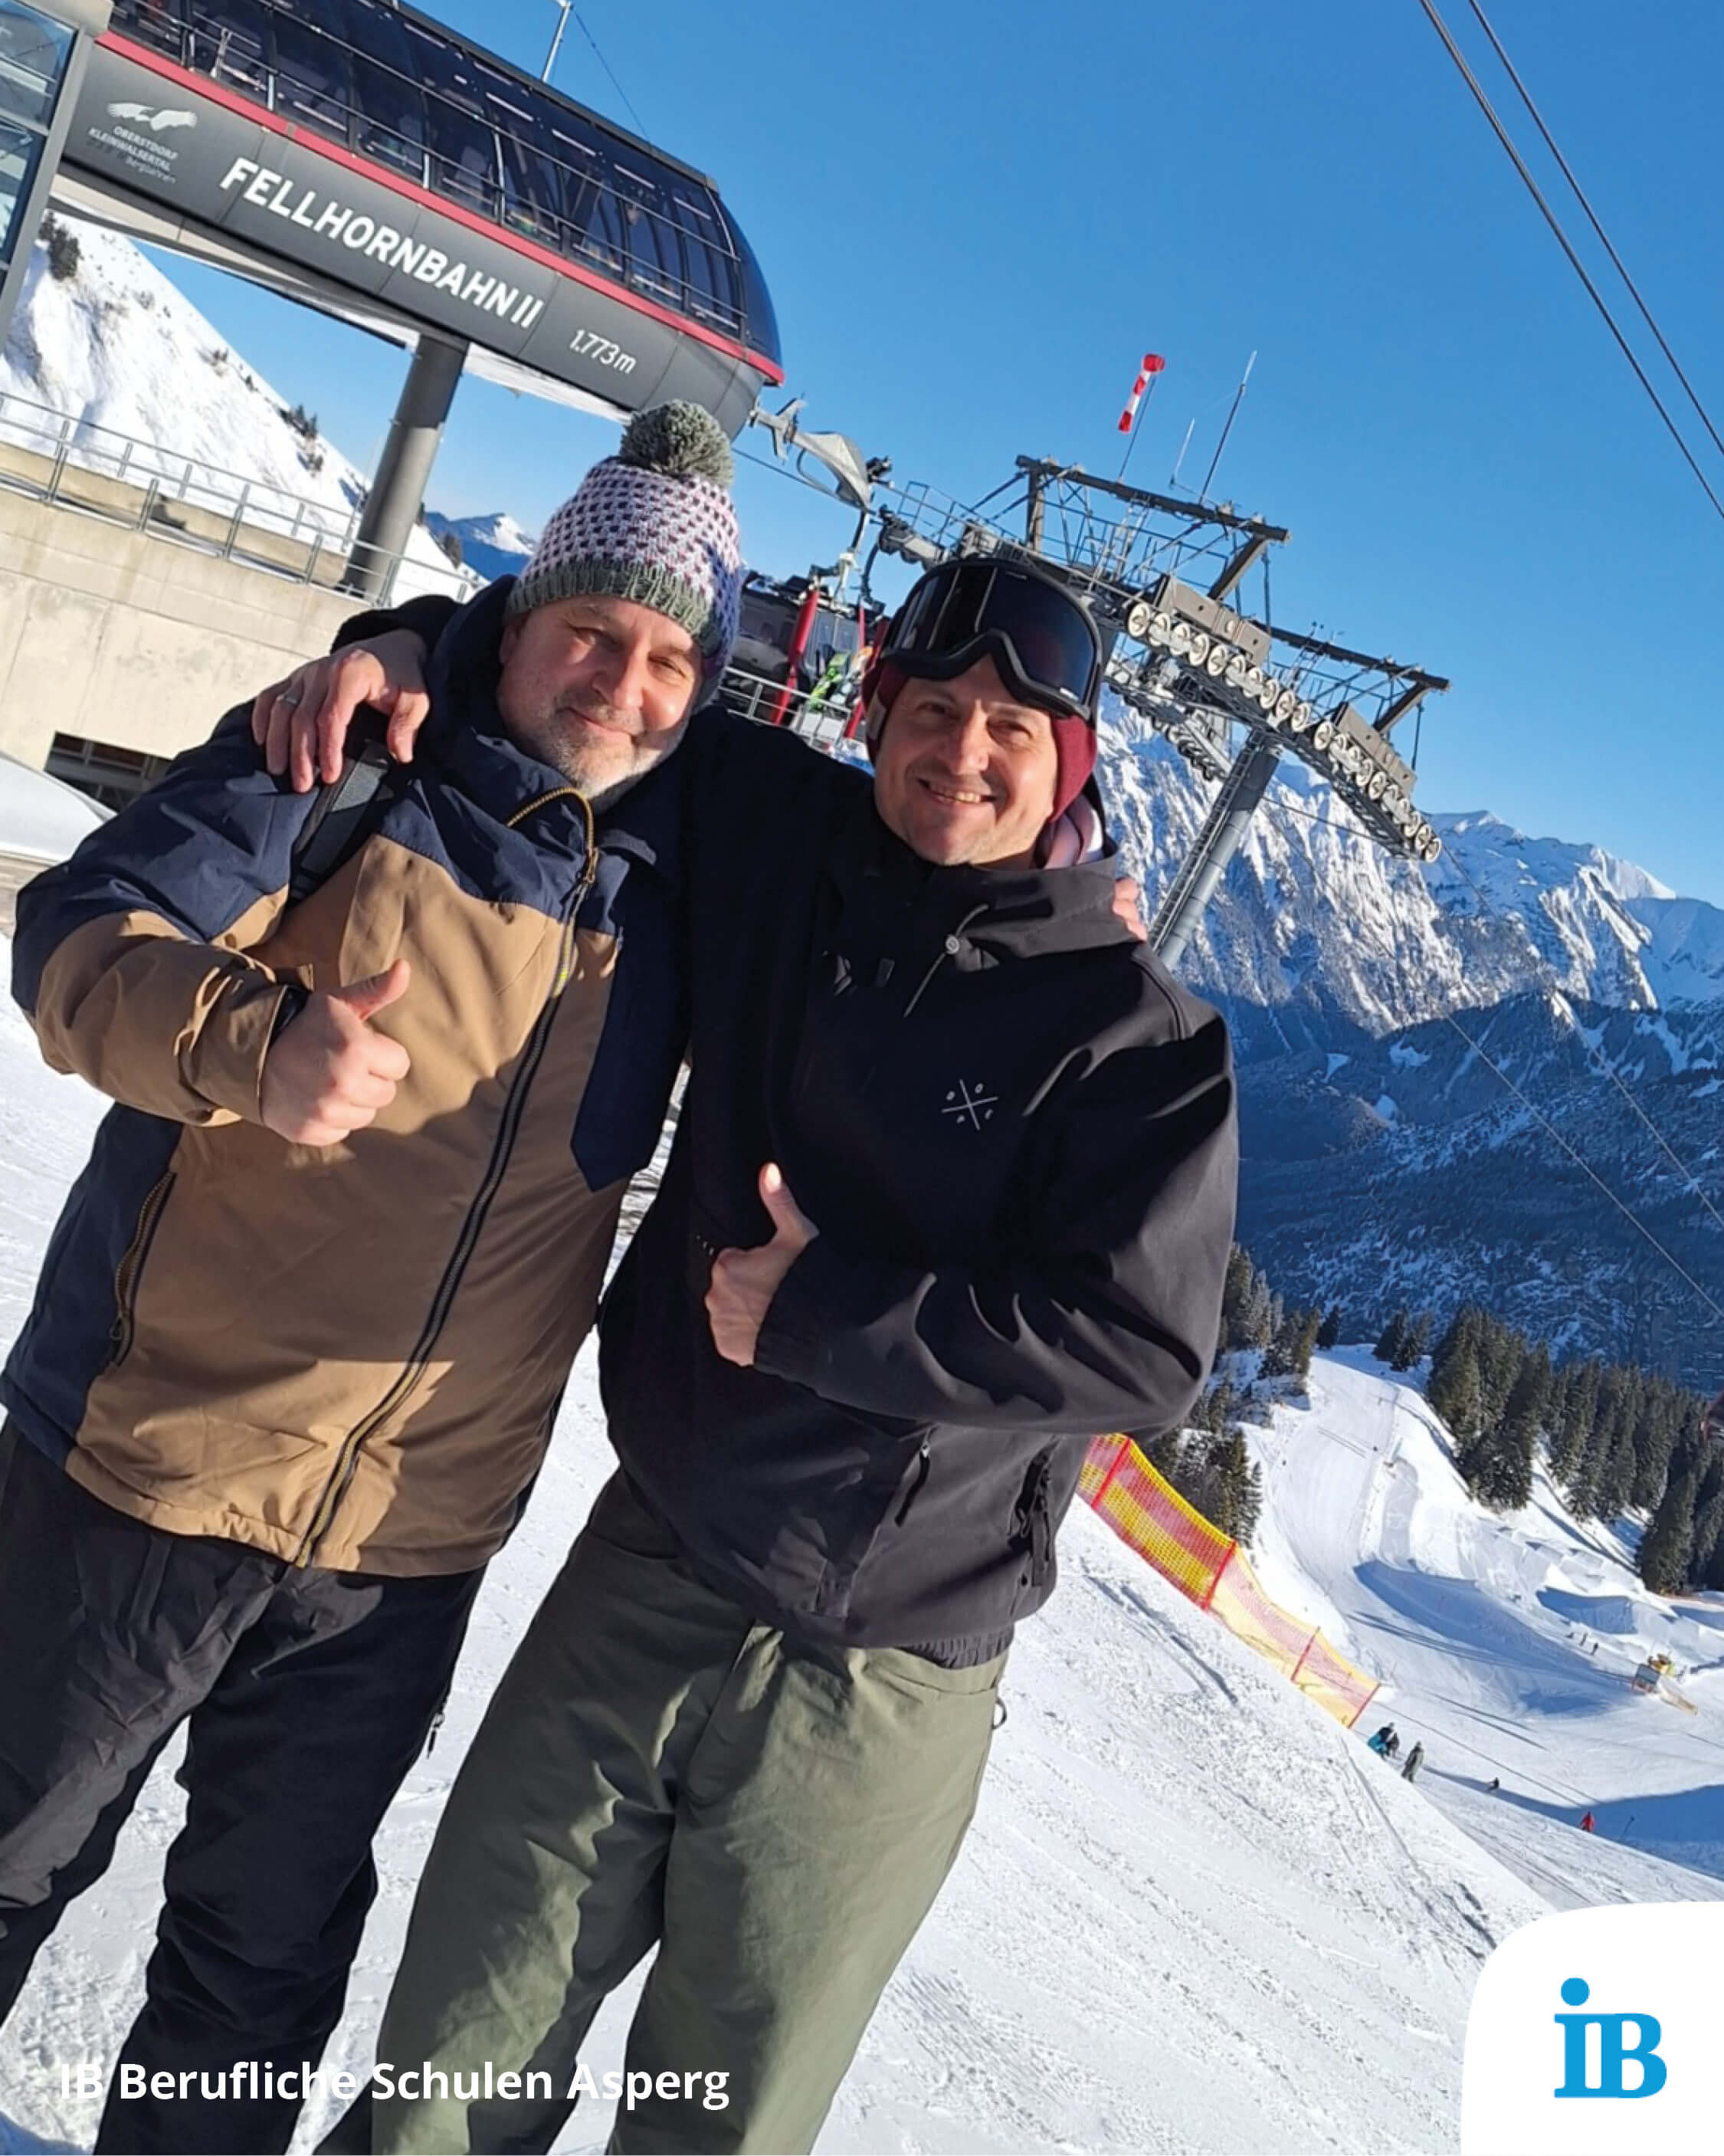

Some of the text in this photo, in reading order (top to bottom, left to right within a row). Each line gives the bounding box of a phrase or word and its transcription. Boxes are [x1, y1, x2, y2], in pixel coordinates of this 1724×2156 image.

[87, 126, 171, 172] KLEINWALSERTAL
[113, 125, 179, 160] OBERSTDORF
[218, 156, 547, 330] FELLHORNBAHN II
